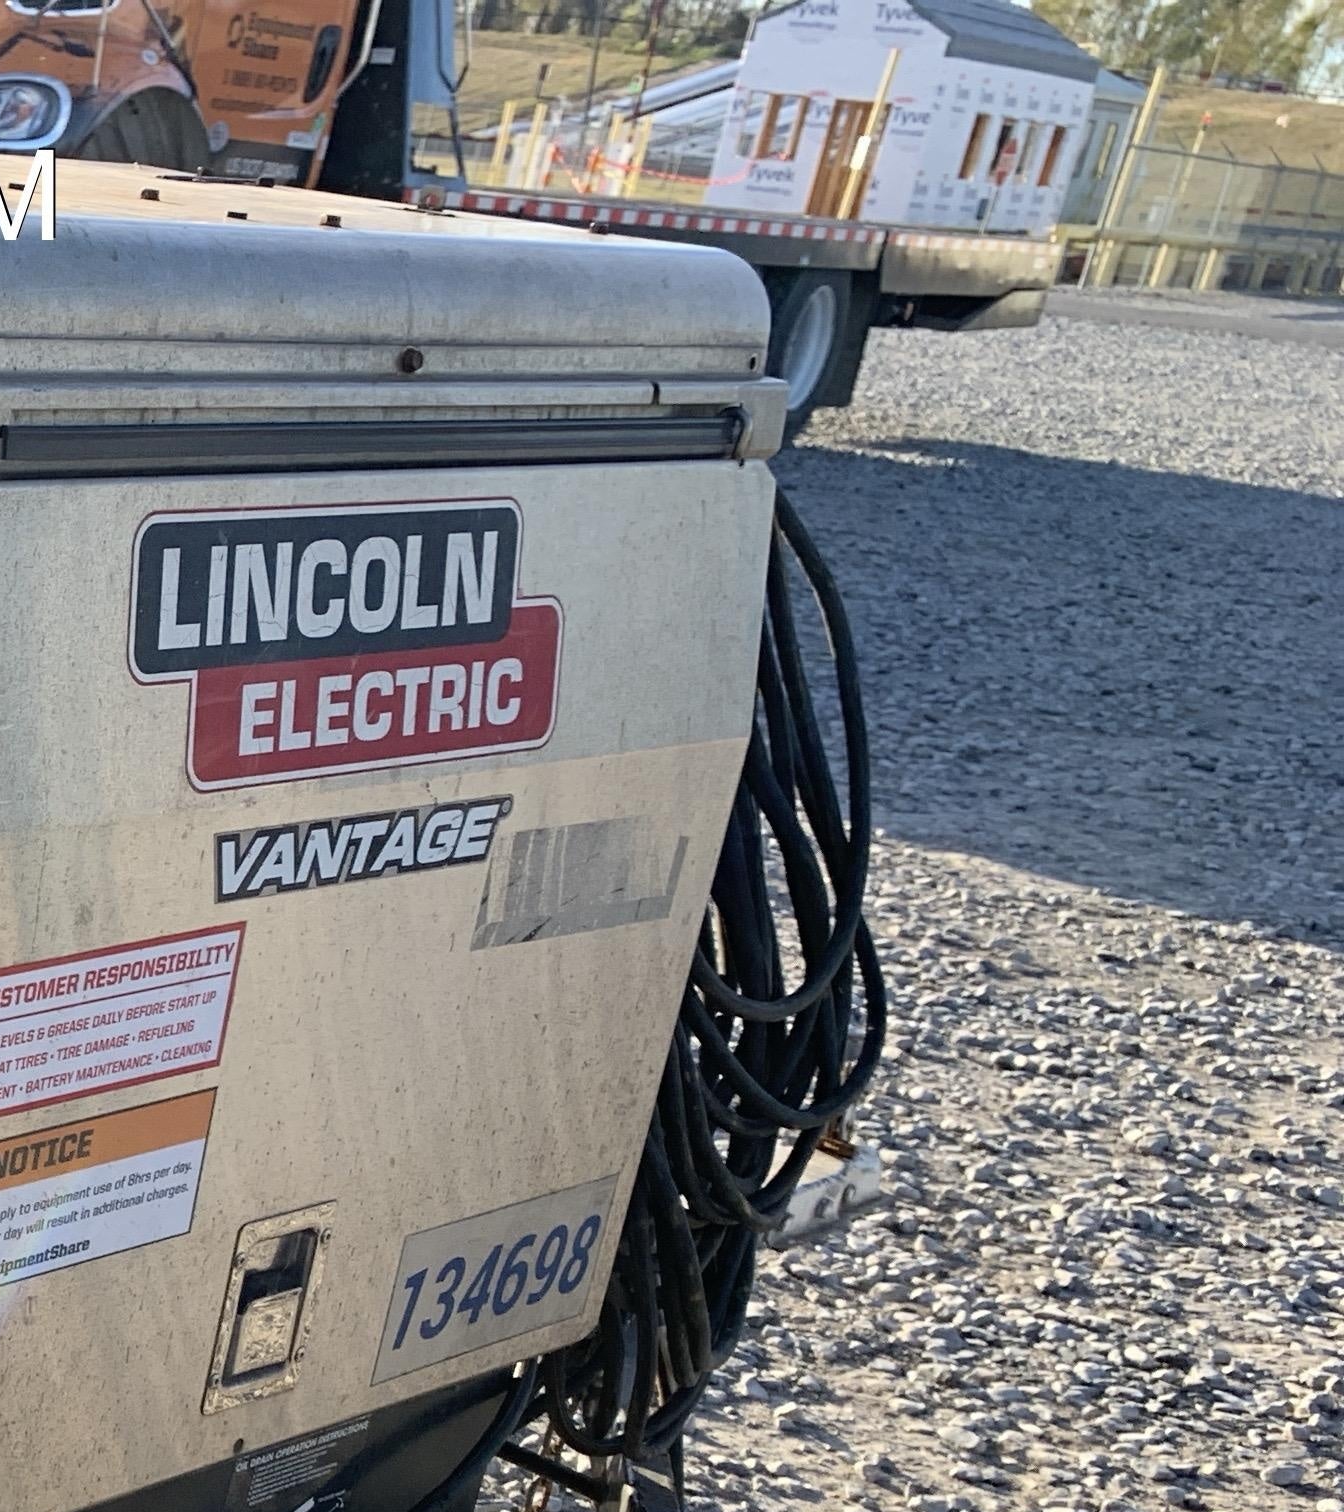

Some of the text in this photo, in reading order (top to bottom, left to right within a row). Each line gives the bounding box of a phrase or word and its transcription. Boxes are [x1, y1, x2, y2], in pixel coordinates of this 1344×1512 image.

[158, 530, 499, 651] LINCOLN
[238, 657, 524, 757] ELECTRIC
[220, 802, 500, 896] VANTAGE
[84, 941, 235, 991] RESPONSIBILITY
[13, 1051, 48, 1072] TIRES
[56, 1044, 83, 1063] TIRE
[84, 1034, 130, 1056] DAMAGE
[137, 1019, 195, 1043] REFUELING
[37, 1026, 46, 1041] &
[47, 1018, 90, 1039] GREASE
[92, 1010, 124, 1030] DAILY
[126, 1002, 167, 1022] BEFORE
[168, 994, 201, 1014] START
[201, 990, 217, 1006] UP
[25, 1071, 74, 1095] BATTERY
[75, 1052, 154, 1083] MAINTENANCE
[160, 1039, 213, 1063] CLEANING
[4, 1226, 24, 1247] day
[25, 1219, 44, 1236] will
[45, 1211, 78, 1231] result
[80, 1207, 91, 1221] in
[92, 1191, 145, 1219] additional
[146, 1182, 190, 1208] charges.
[18, 1202, 31, 1218] to
[33, 1187, 91, 1216] equipment
[93, 1182, 113, 1197] use
[114, 1175, 126, 1191] of
[127, 1170, 152, 1188] 8hrs
[153, 1166, 170, 1185] per
[172, 1160, 192, 1182] day.
[392, 1214, 603, 1352] 134698
